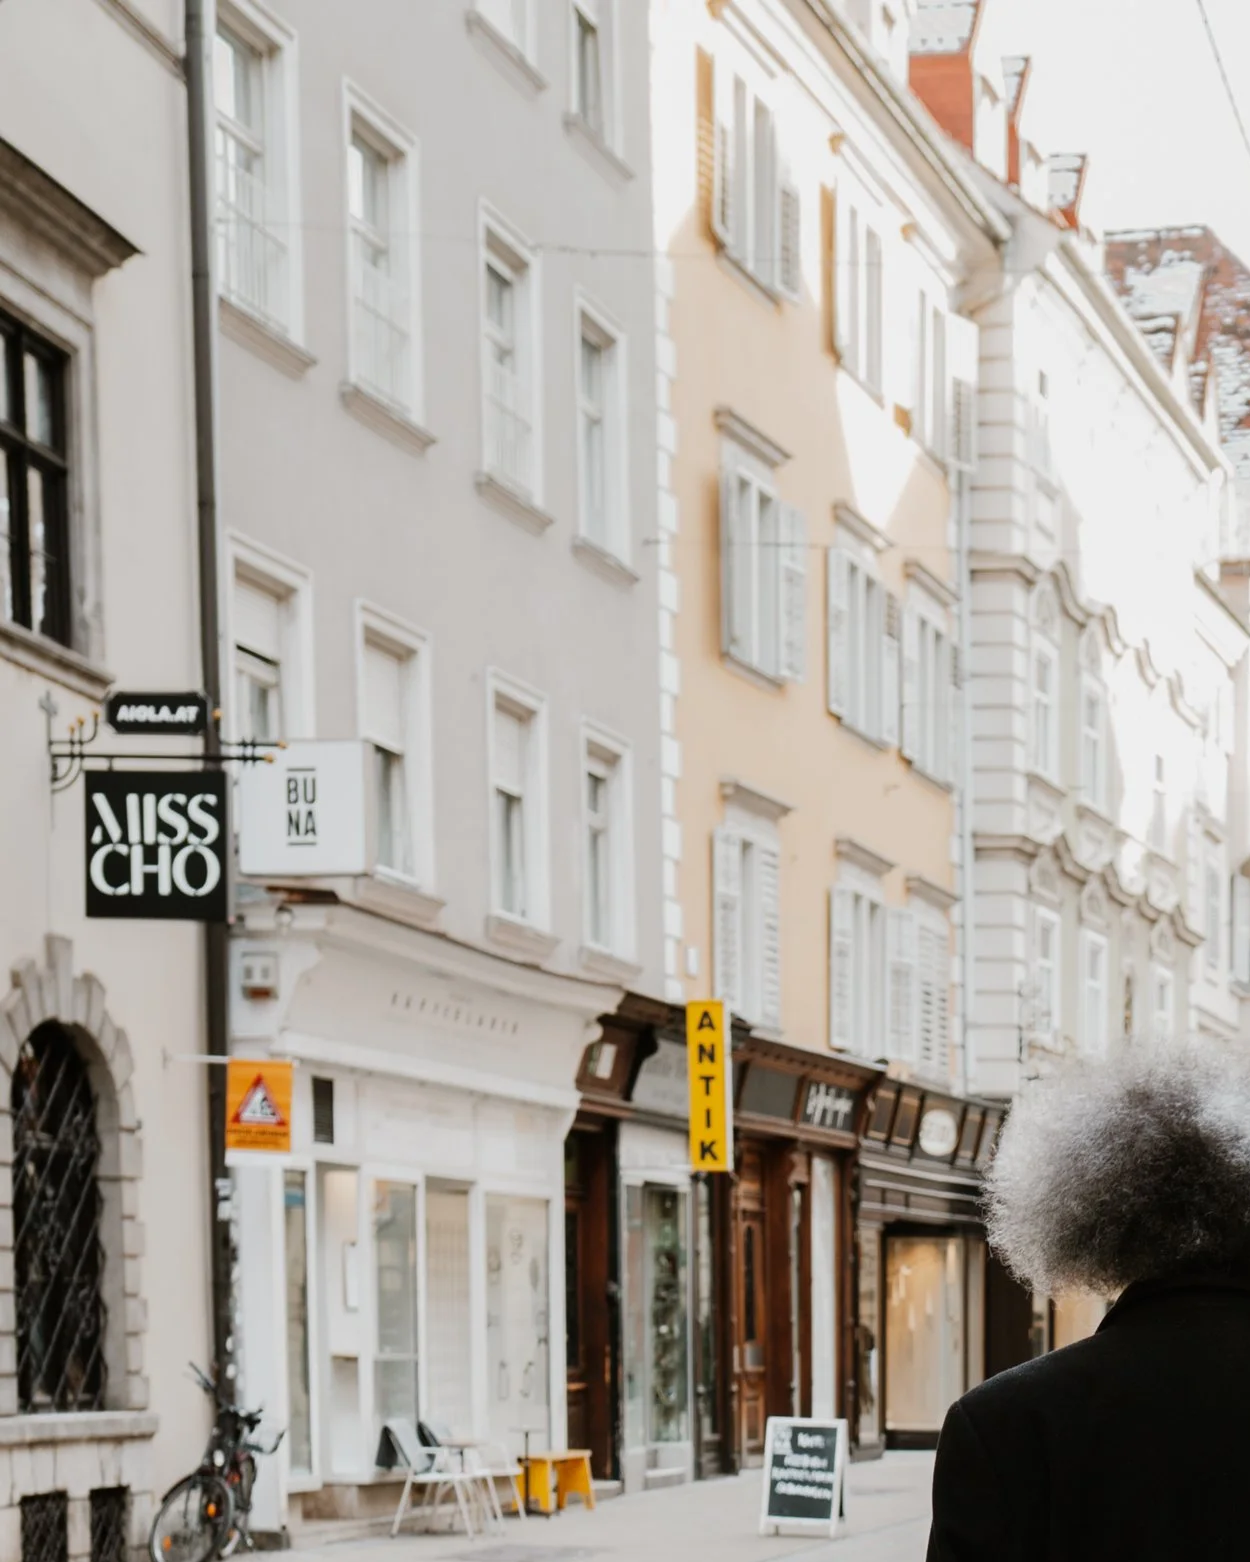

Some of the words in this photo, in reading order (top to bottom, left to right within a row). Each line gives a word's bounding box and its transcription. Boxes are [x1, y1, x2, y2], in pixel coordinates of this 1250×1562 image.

[116, 704, 199, 722] AIOLA.AT
[286, 777, 317, 804] BU
[90, 792, 220, 846] MISS
[286, 811, 317, 837] NA
[89, 843, 221, 896] CHO
[697, 1010, 718, 1161] ANTIK
